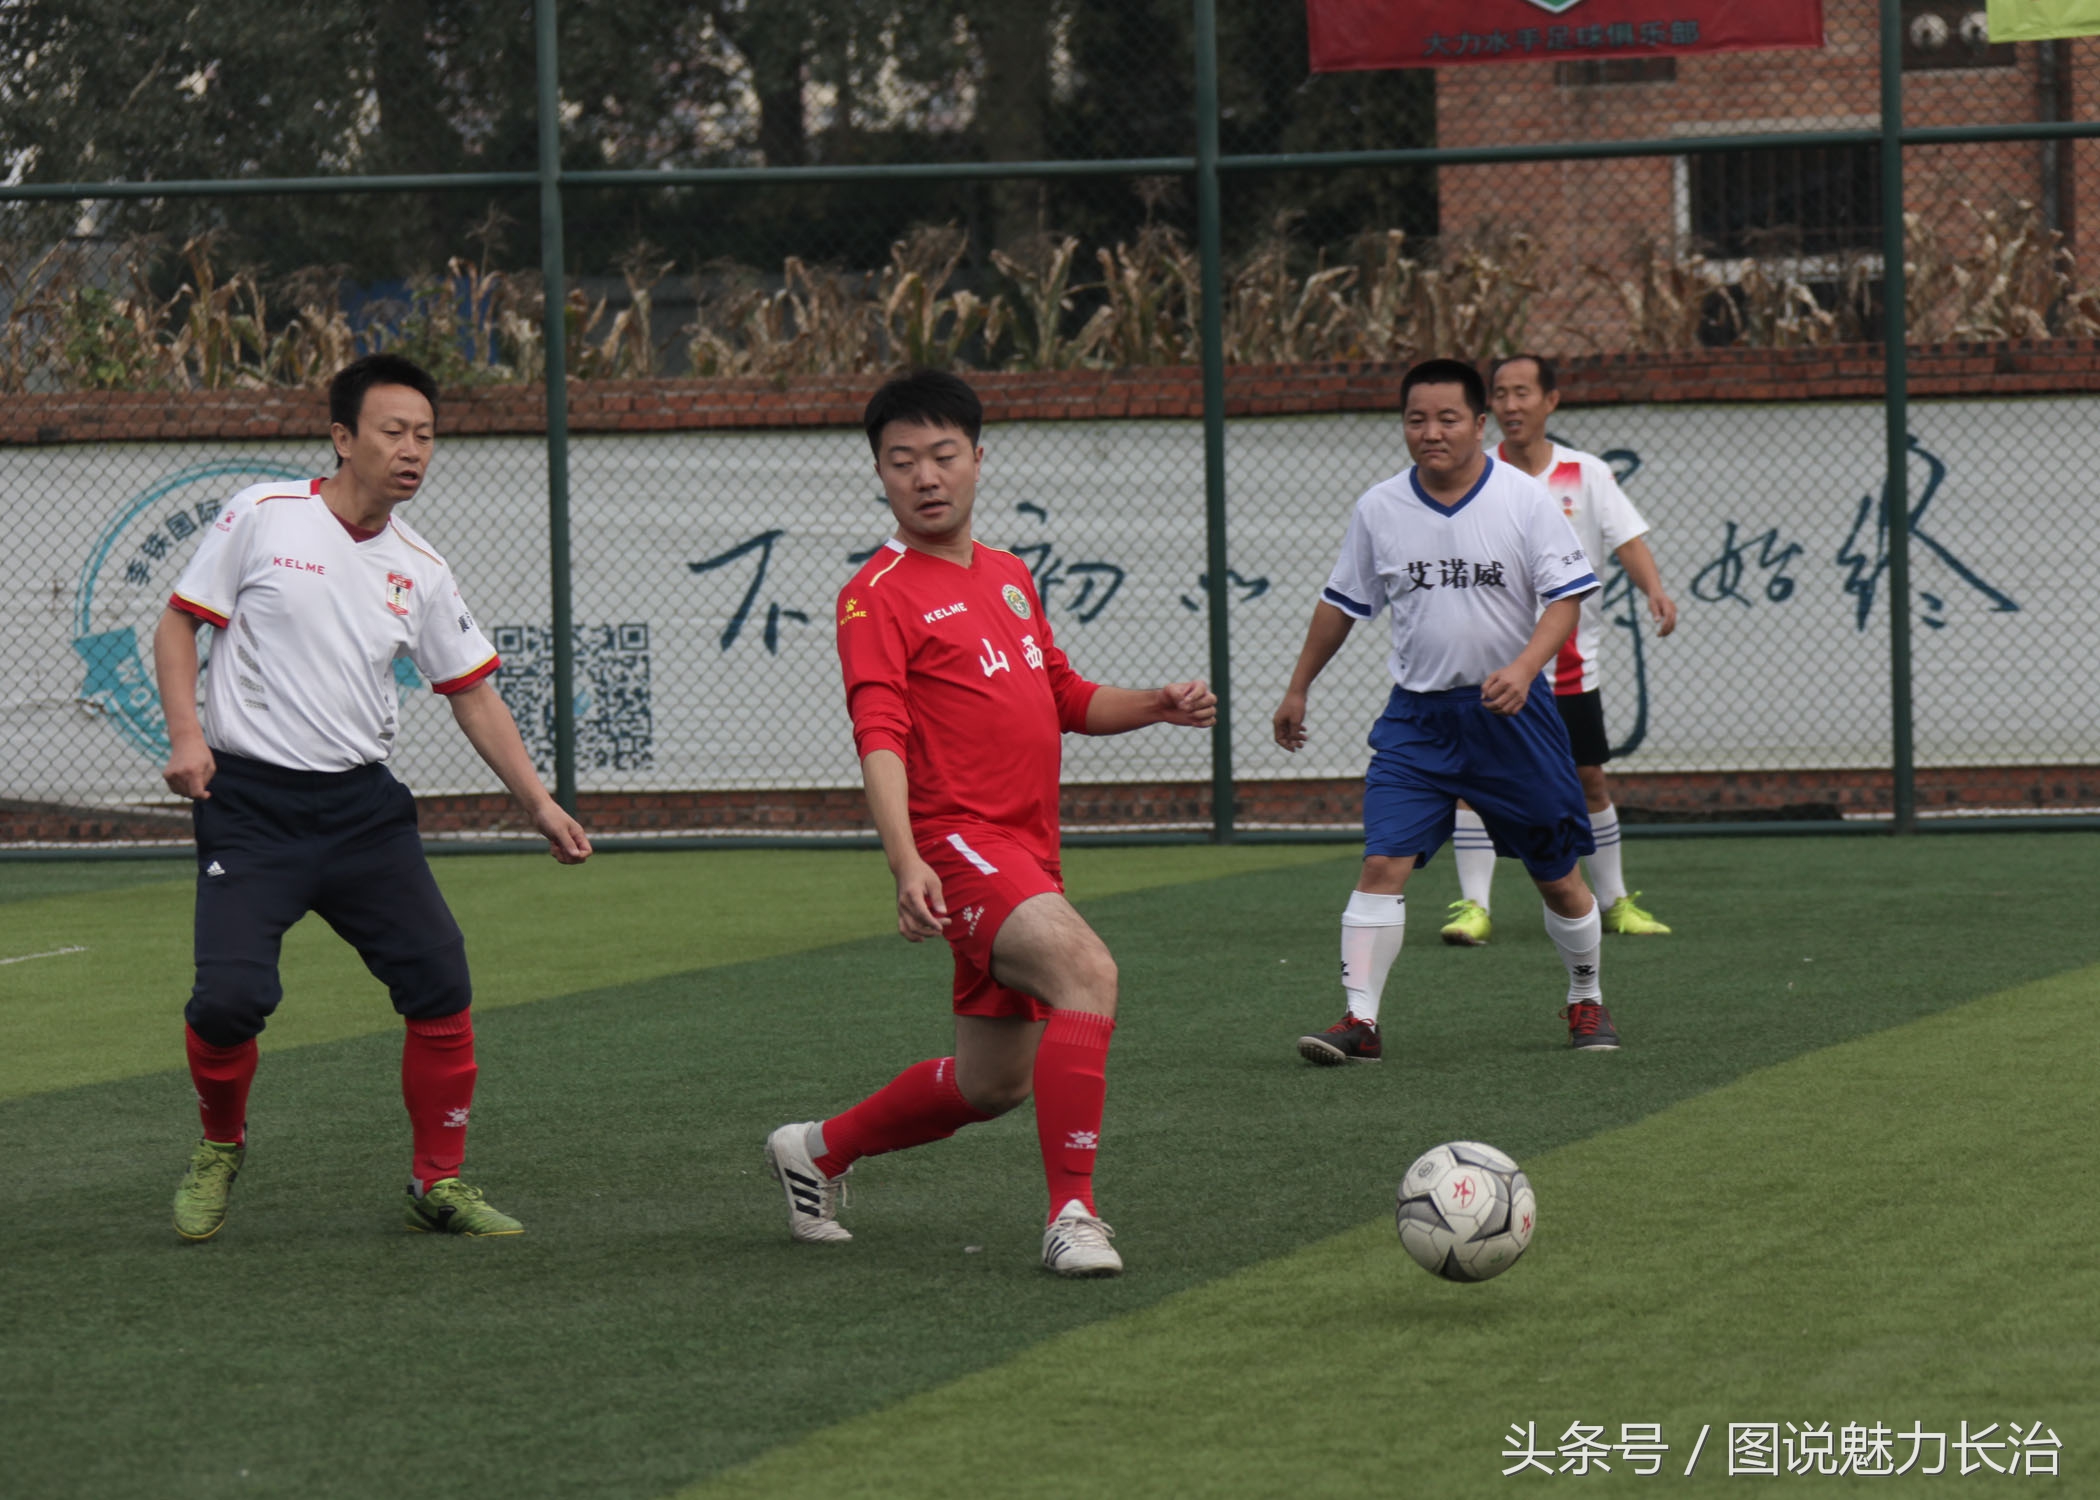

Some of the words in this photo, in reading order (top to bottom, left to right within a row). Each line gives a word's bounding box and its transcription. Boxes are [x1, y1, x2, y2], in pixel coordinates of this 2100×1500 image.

[1423, 19, 1700, 56] 大力水手足球俱乐部
[273, 556, 326, 575] KELME
[1402, 558, 1507, 593] 艾诺威
[923, 602, 968, 624] KELME
[979, 634, 1044, 678] 山西
